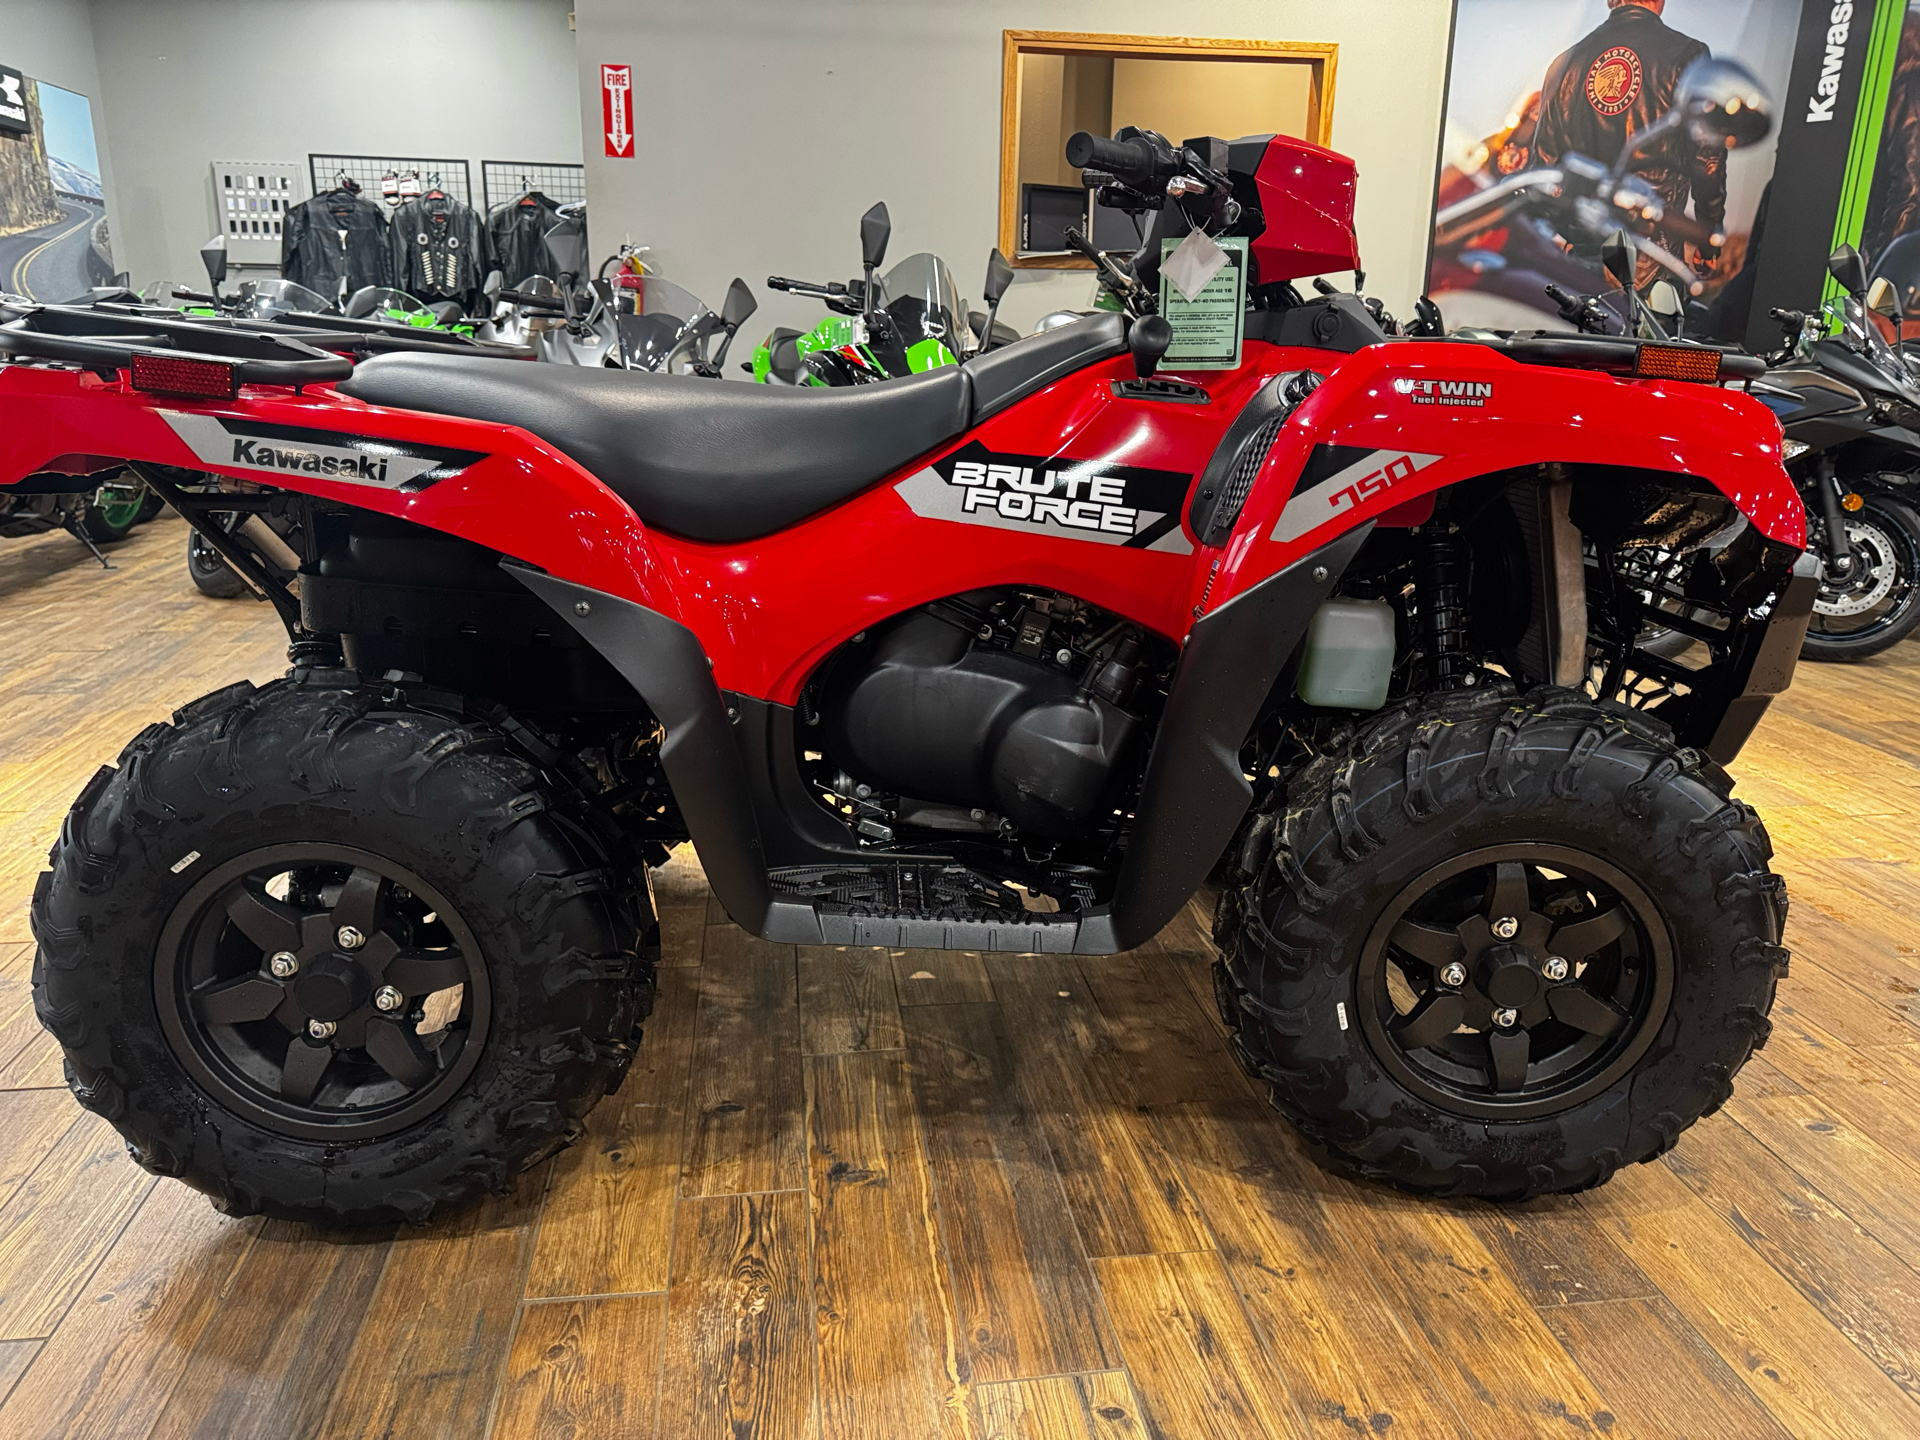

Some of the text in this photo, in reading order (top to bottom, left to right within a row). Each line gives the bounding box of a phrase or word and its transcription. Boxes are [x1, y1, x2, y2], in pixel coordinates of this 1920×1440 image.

[606, 73, 627, 86] FIRE
[1588, 49, 1641, 104] INDIAN MOTORCYCLE
[1806, 0, 1854, 122] Kawas
[614, 88, 623, 149] EXTINGUISHER
[1394, 378, 1492, 398] V-TWIN
[1412, 395, 1484, 407] Fuel Injected
[232, 439, 388, 482] Kawasaki
[952, 461, 1126, 504] BRUTE
[1328, 455, 1416, 507] 750
[964, 487, 1136, 534] FORCE
